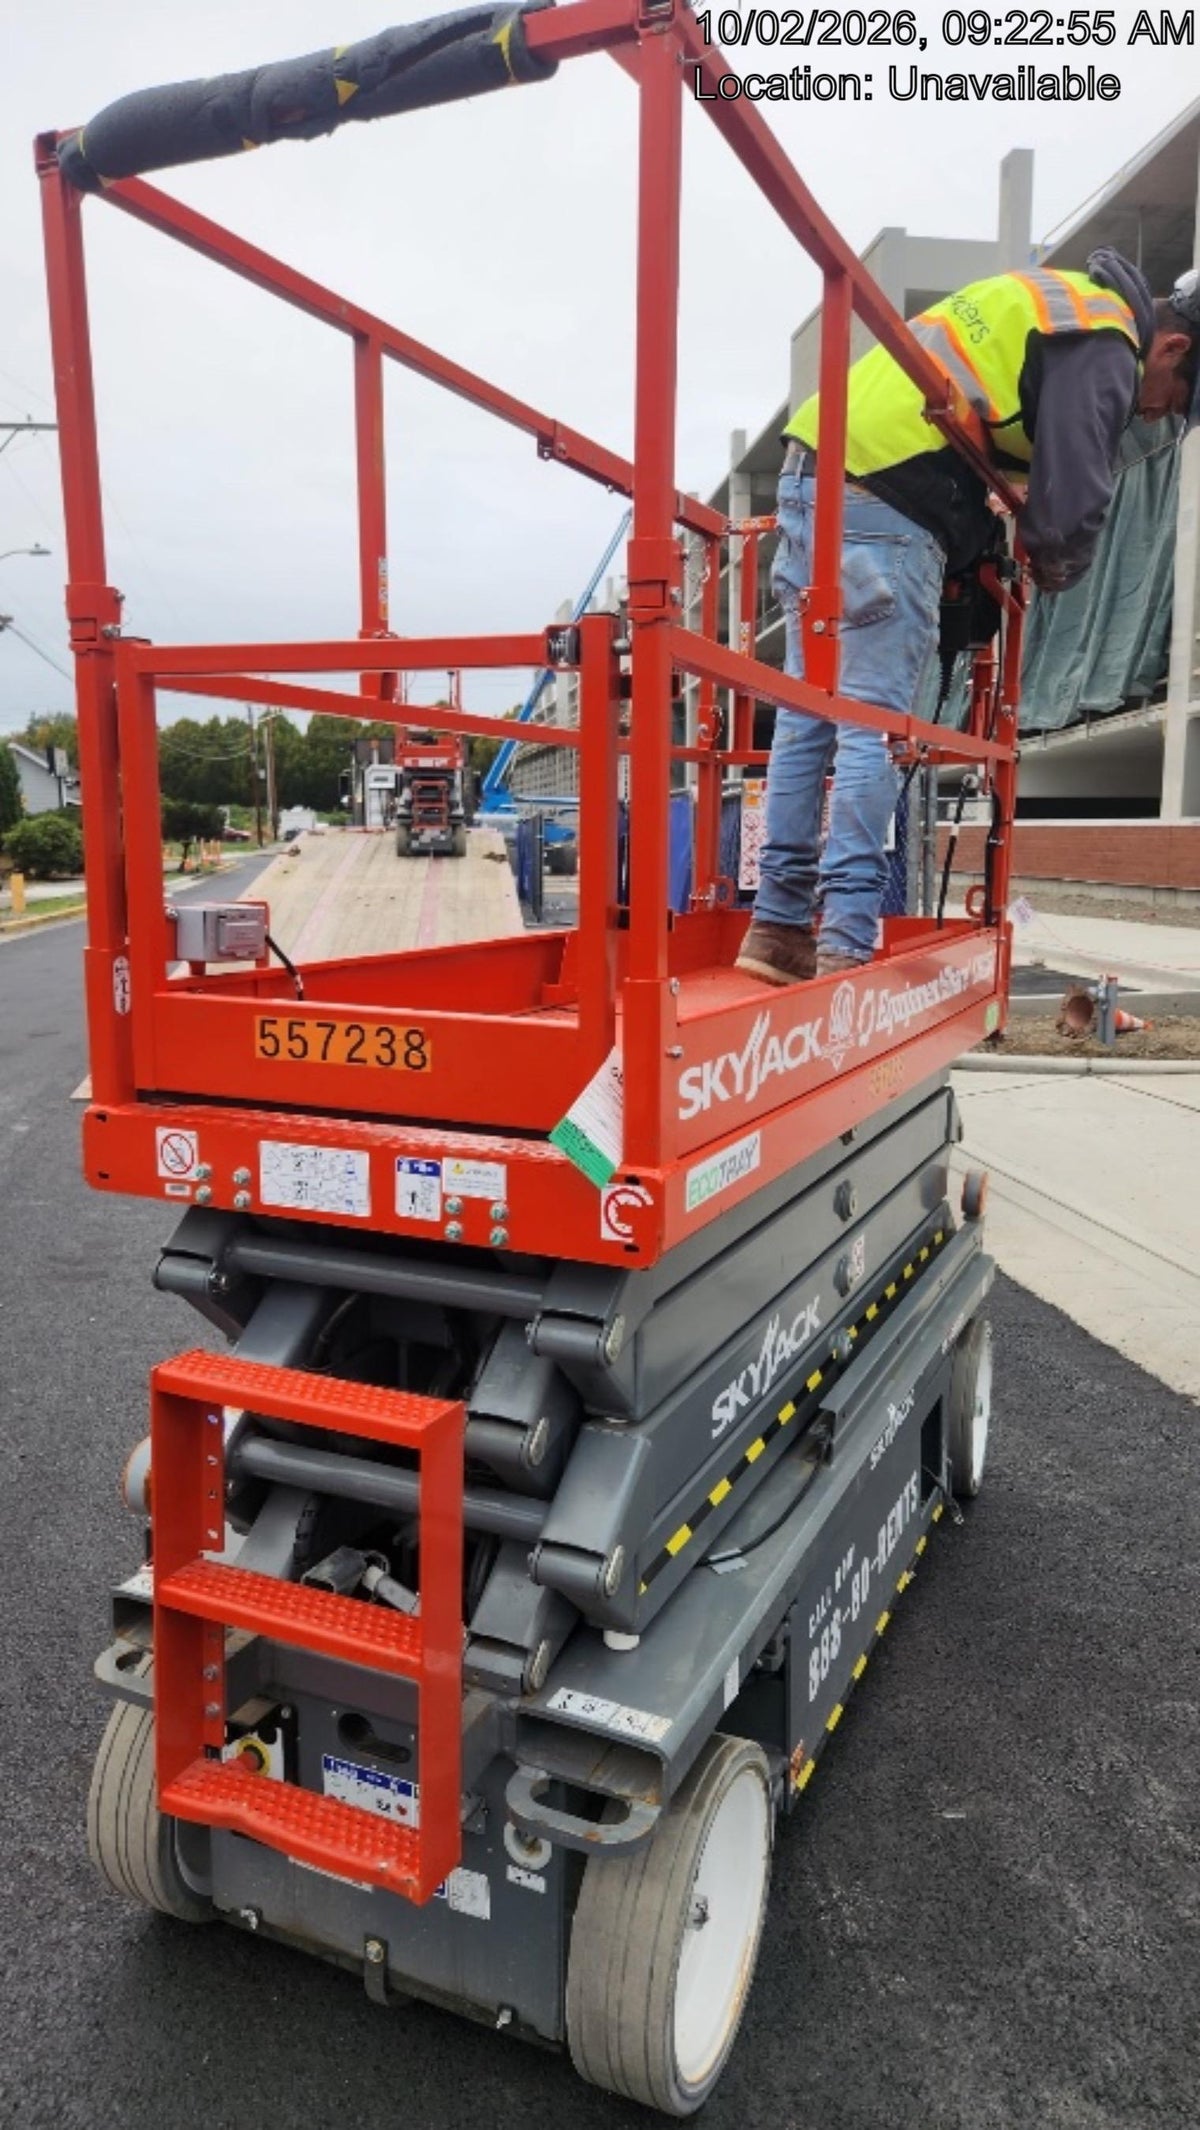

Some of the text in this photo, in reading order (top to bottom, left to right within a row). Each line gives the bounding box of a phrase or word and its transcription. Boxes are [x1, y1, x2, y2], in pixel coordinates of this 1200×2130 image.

[258, 1018, 428, 1071] 557238
[678, 1009, 824, 1120] SKYJACK
[711, 1294, 821, 1440] SKYJACK
